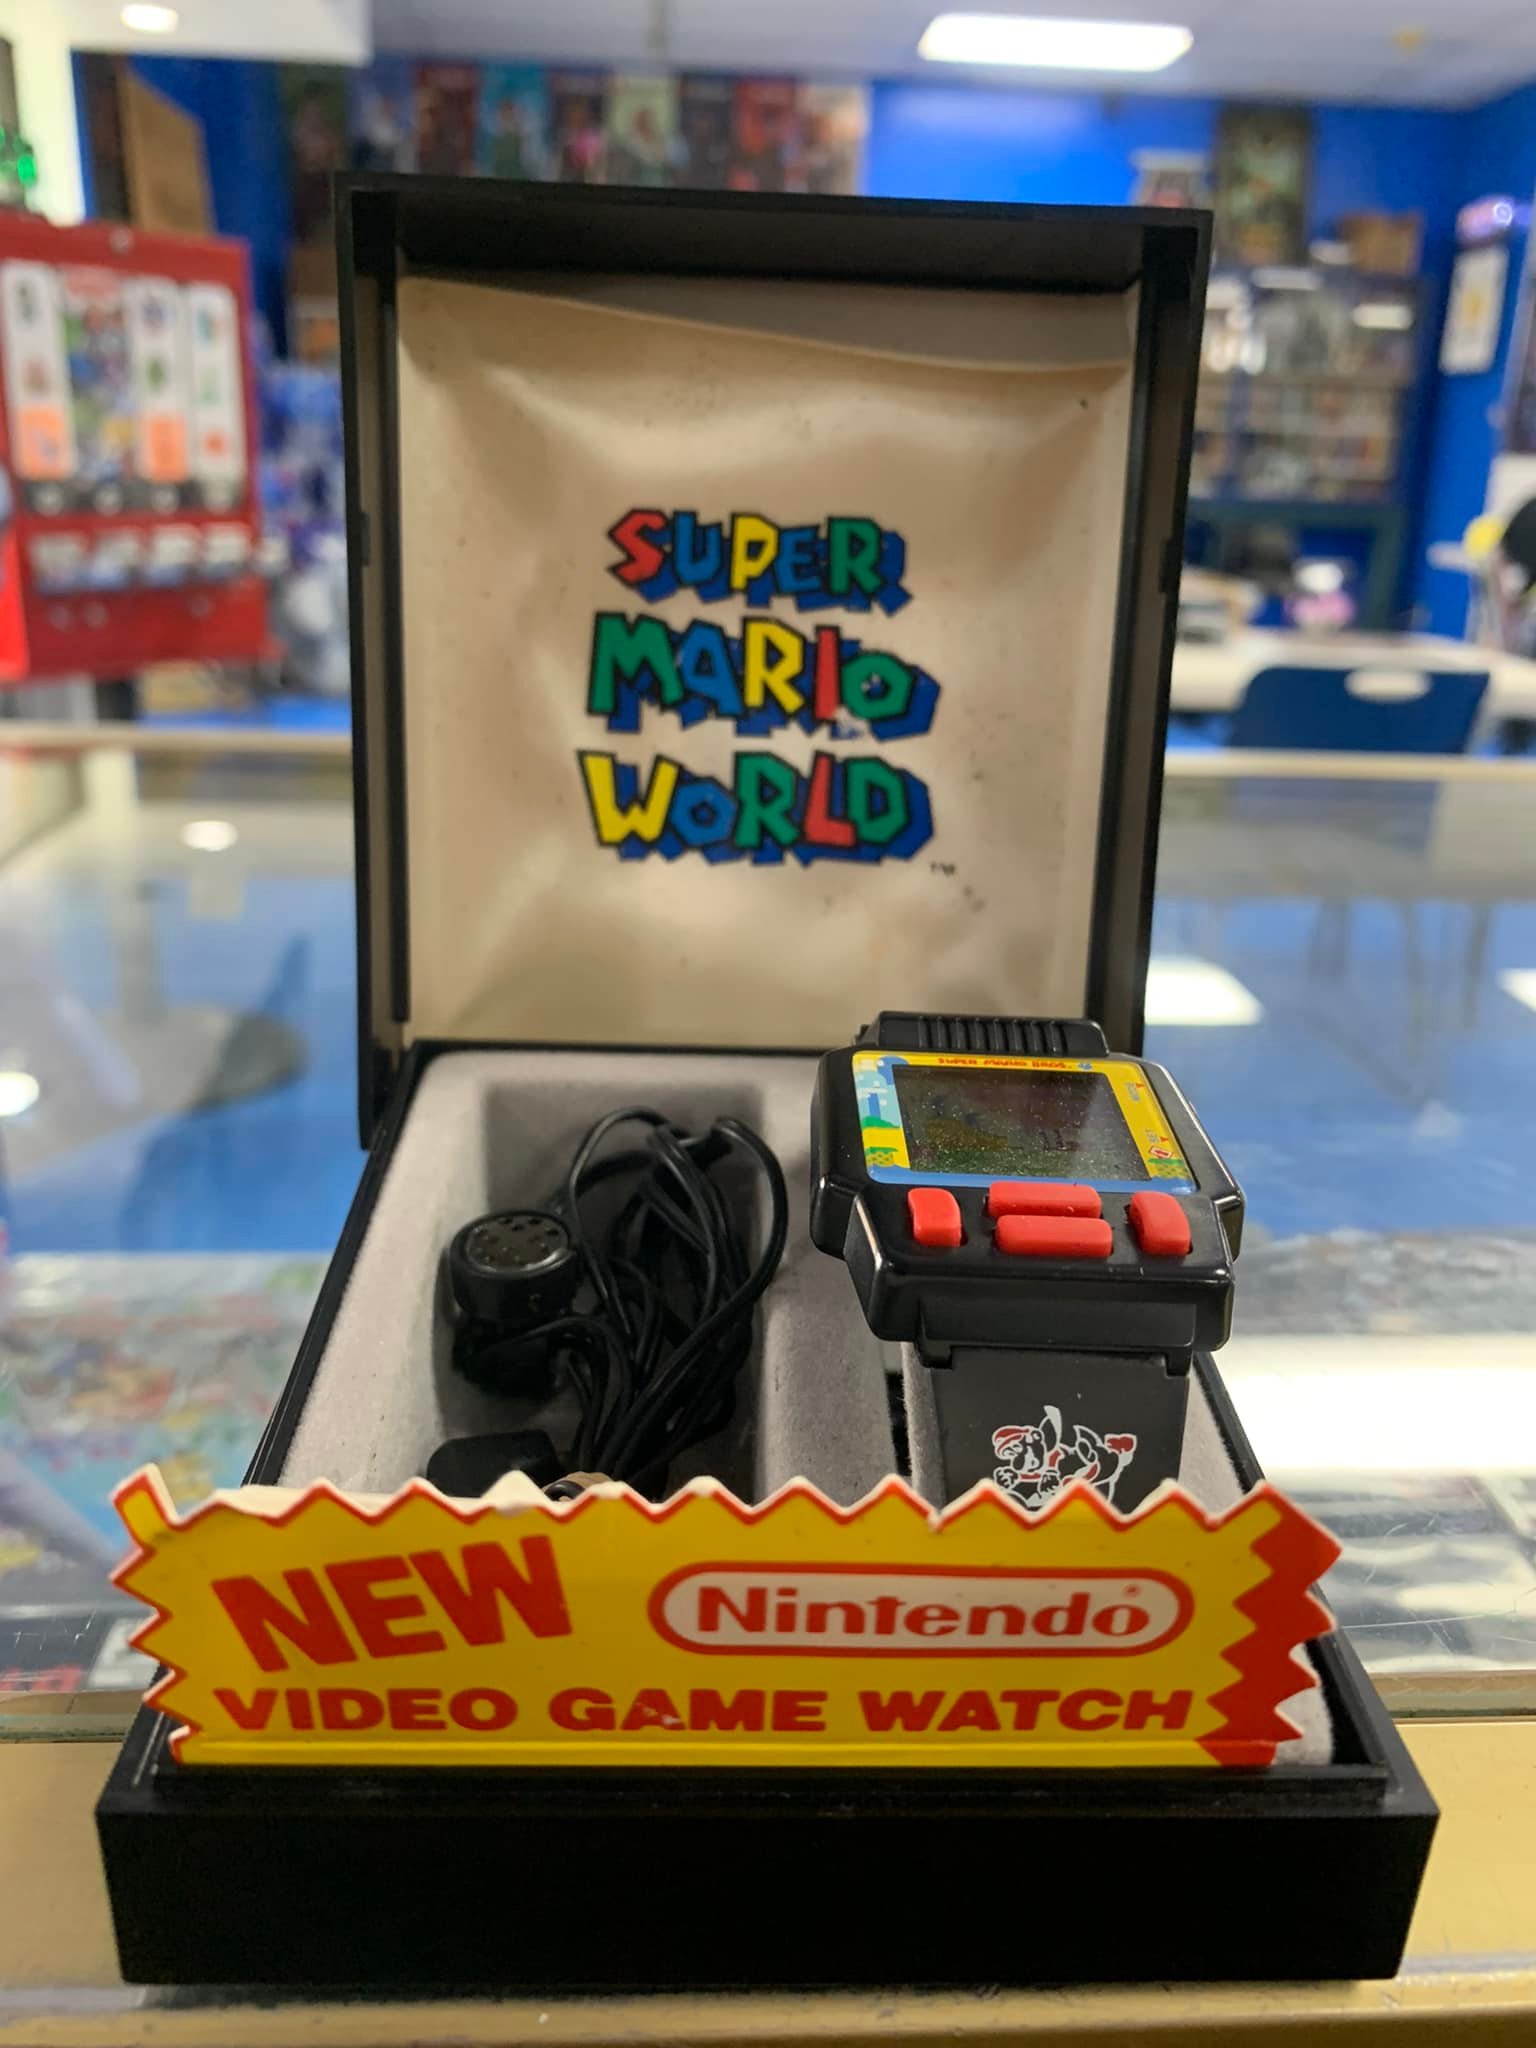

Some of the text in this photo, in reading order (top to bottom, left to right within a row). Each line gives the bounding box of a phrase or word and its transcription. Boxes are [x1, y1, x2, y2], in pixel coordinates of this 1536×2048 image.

[607, 508, 910, 614] SUPER
[588, 611, 940, 741] MARIO
[577, 750, 934, 867] WORLD
[211, 1535, 573, 1673] NEW
[698, 1585, 1150, 1637] Nintendo
[213, 1687, 1194, 1732] VIDEO GAME WATCH
